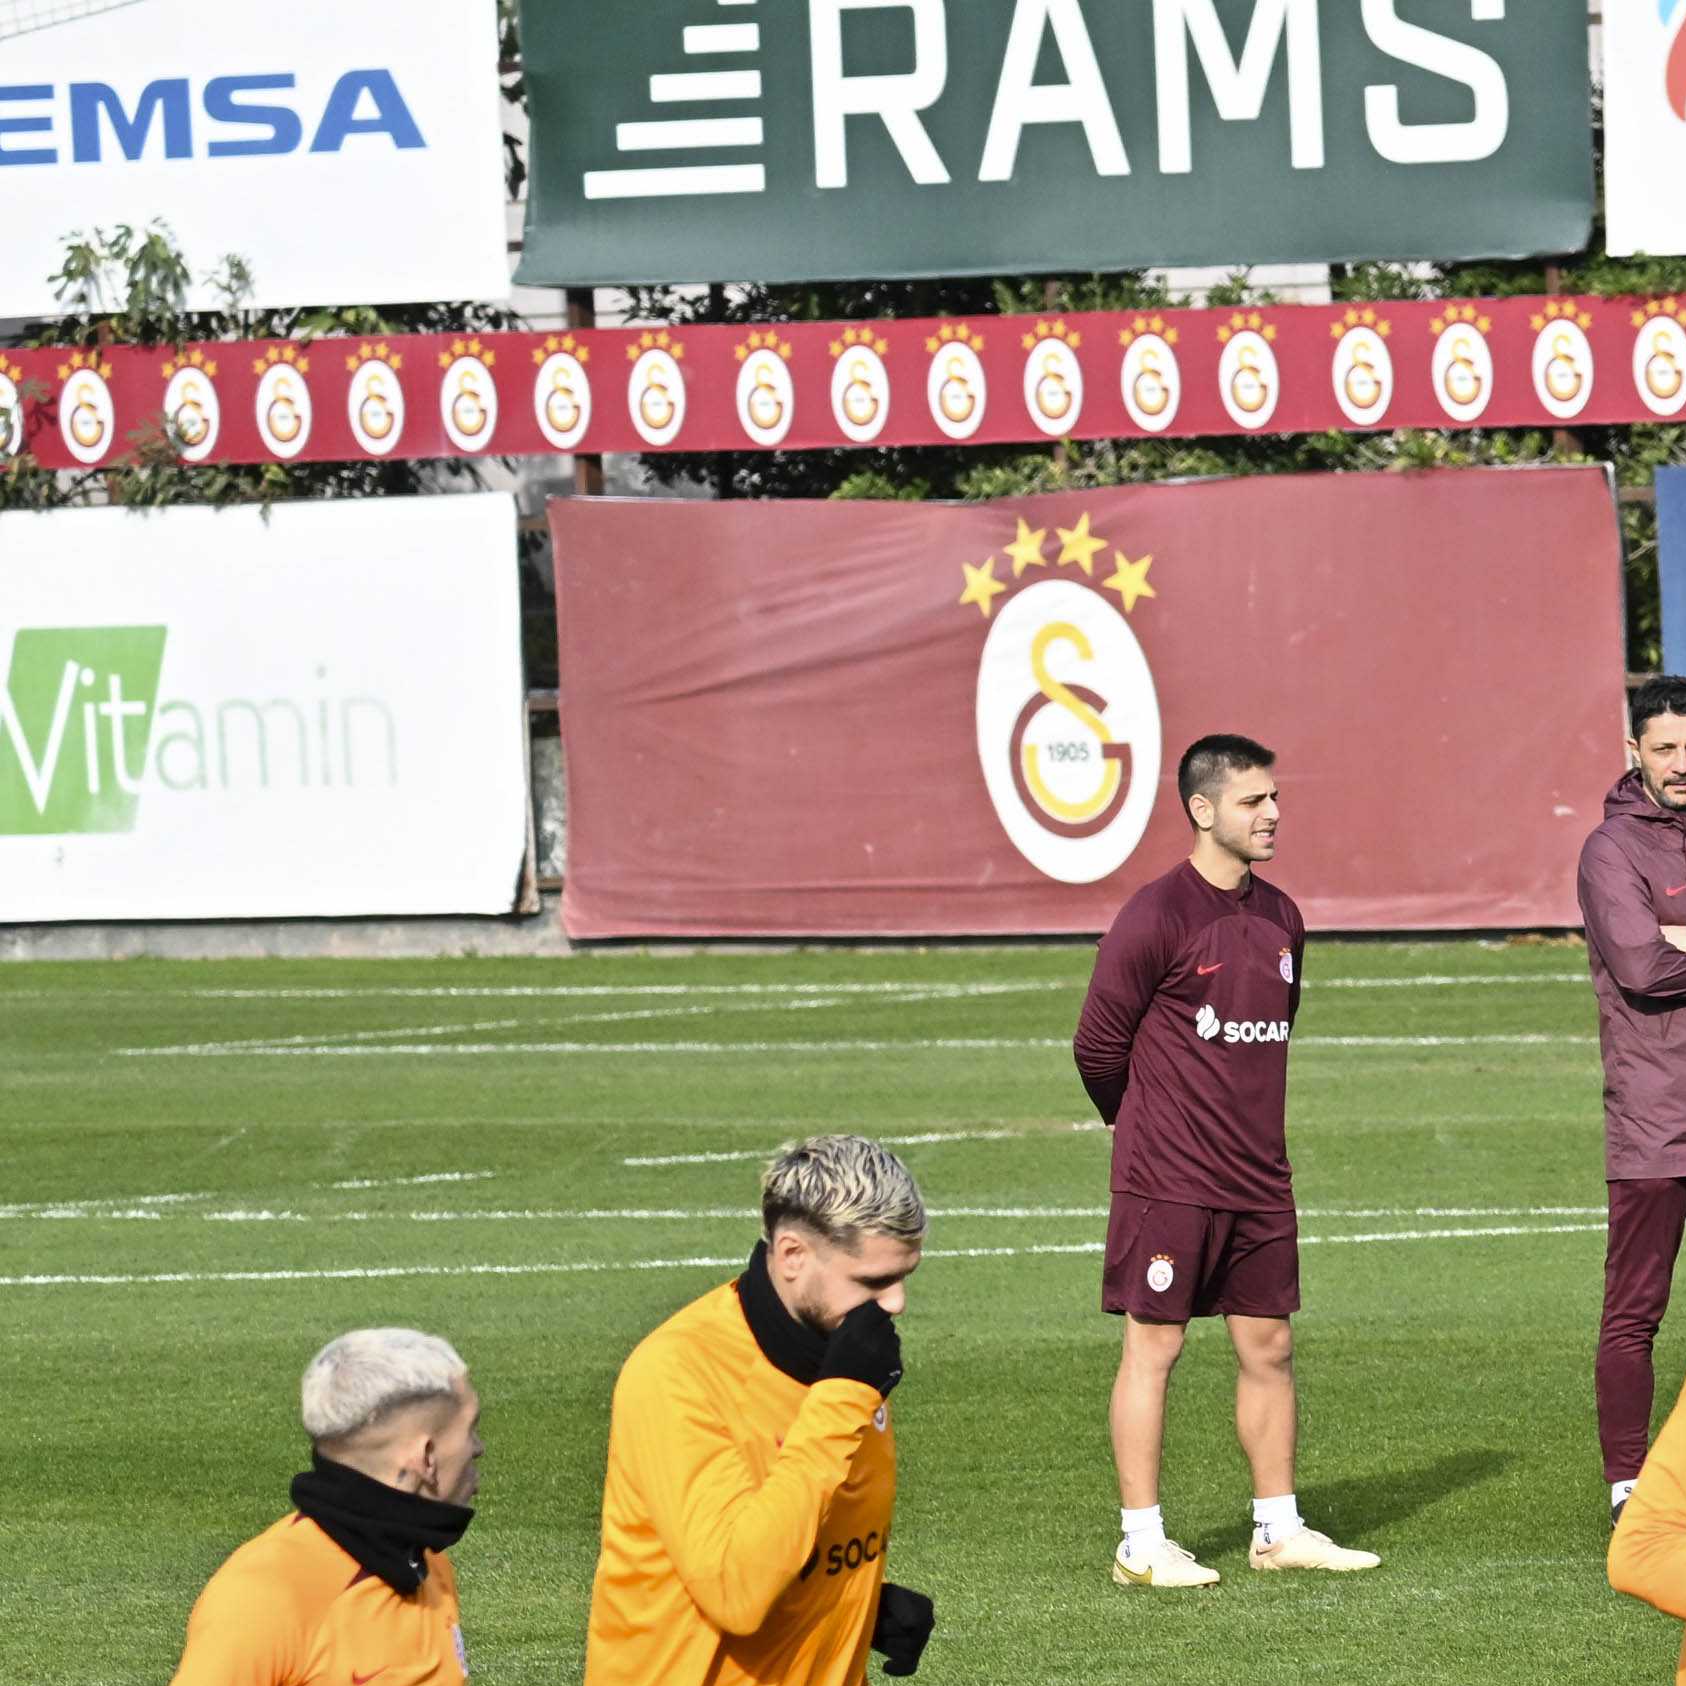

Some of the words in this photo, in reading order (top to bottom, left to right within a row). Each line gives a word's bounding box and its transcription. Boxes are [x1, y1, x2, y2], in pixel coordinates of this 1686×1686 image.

[809, 0, 1509, 189] RAMS
[0, 660, 399, 816] Vitamin
[1047, 741, 1089, 762] 1905
[1223, 1020, 1289, 1043] SOCAR
